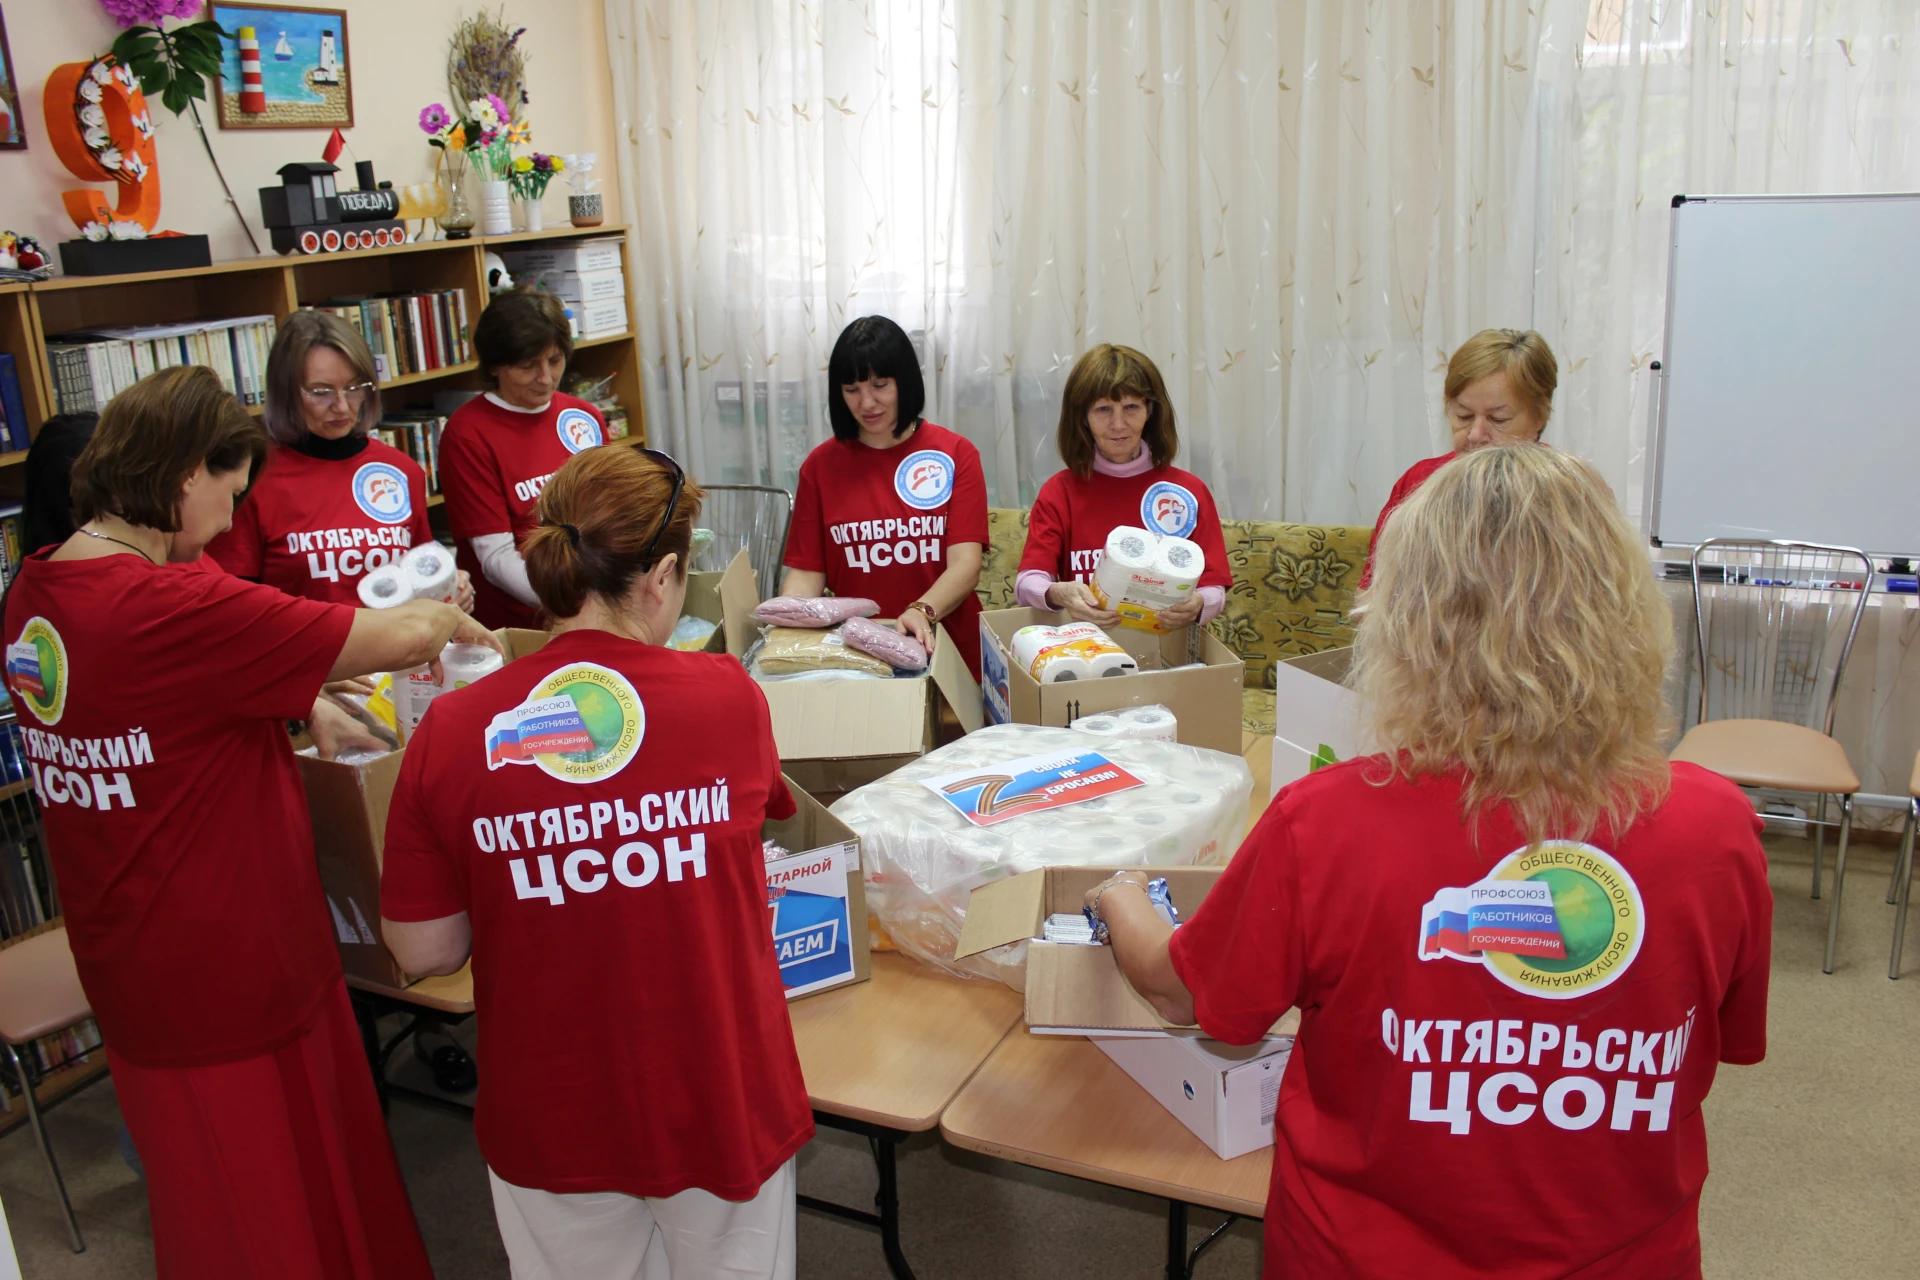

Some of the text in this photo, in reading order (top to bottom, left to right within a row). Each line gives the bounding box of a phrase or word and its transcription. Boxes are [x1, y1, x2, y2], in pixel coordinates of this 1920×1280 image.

[339, 192, 393, 211] ПОБЕДА!
[830, 514, 948, 545] ОКТЯБРЬСКИ
[844, 538, 940, 573] ЦСОН
[516, 700, 571, 718] ПРОФСОЮЗ
[548, 670, 636, 775] ОБЩЕСТВЕННОГО ОБСЛУЖИВАНИЯ
[520, 717, 580, 733] РАБОТНИКОВ
[19, 726, 154, 769] ТЯБРЬСКИЙ
[523, 736, 589, 750] ГОСУЧРЕЖДЕНИЙ
[1031, 756, 1081, 773] СВОИХ
[1058, 768, 1081, 779] НЕ
[1044, 770, 1119, 795] БРОСАЕМ!
[472, 778, 730, 853] ОКТЯБРЬСКИЙ
[509, 833, 707, 906] ЦСОН
[766, 857, 832, 886] ИТАРНОЙ
[1471, 889, 1546, 900] ПРОФСОЮЗ
[1472, 911, 1553, 924] РАБОТНИКОВ
[1519, 852, 1630, 987] ОБЩЕСТВЕННОГО ОБСЛУЖИВАНИЯ
[775, 932, 824, 961] АЕМ
[1471, 935, 1561, 949] ГОСУЧРЕЖДЕНИЙ
[1381, 1005, 1696, 1076] ОКТЯБРЬСКИЙ
[1409, 1071, 1676, 1135] ЦСОН
